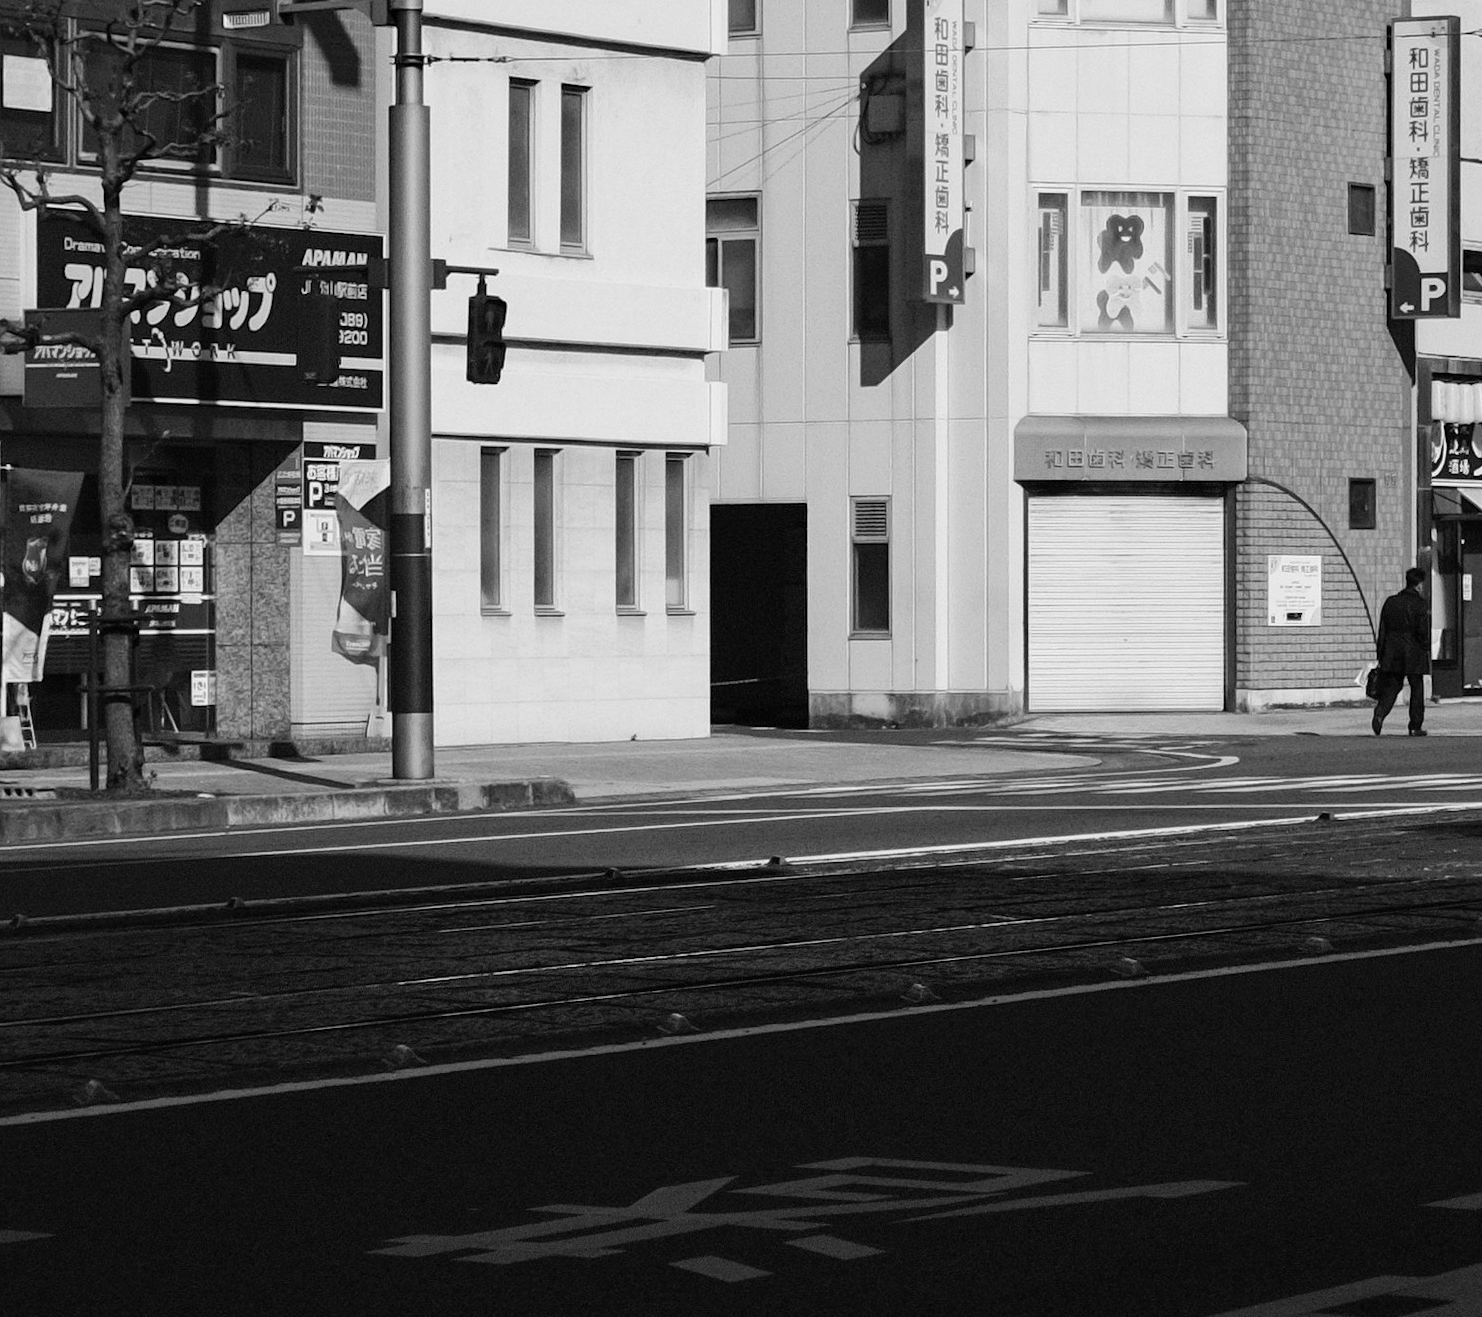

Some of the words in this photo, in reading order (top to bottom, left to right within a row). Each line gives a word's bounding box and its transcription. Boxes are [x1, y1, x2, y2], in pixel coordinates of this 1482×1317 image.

[1433, 48, 1441, 79] WADA
[1433, 81, 1441, 122] DENTAL
[1408, 47, 1430, 253] 和田歯科・矯正歯科
[1433, 125, 1441, 158] CLINIC
[301, 248, 368, 267] APAMAN
[929, 259, 948, 296] P
[1420, 277, 1447, 312] P
[308, 481, 323, 508] P
[282, 510, 296, 528] P
